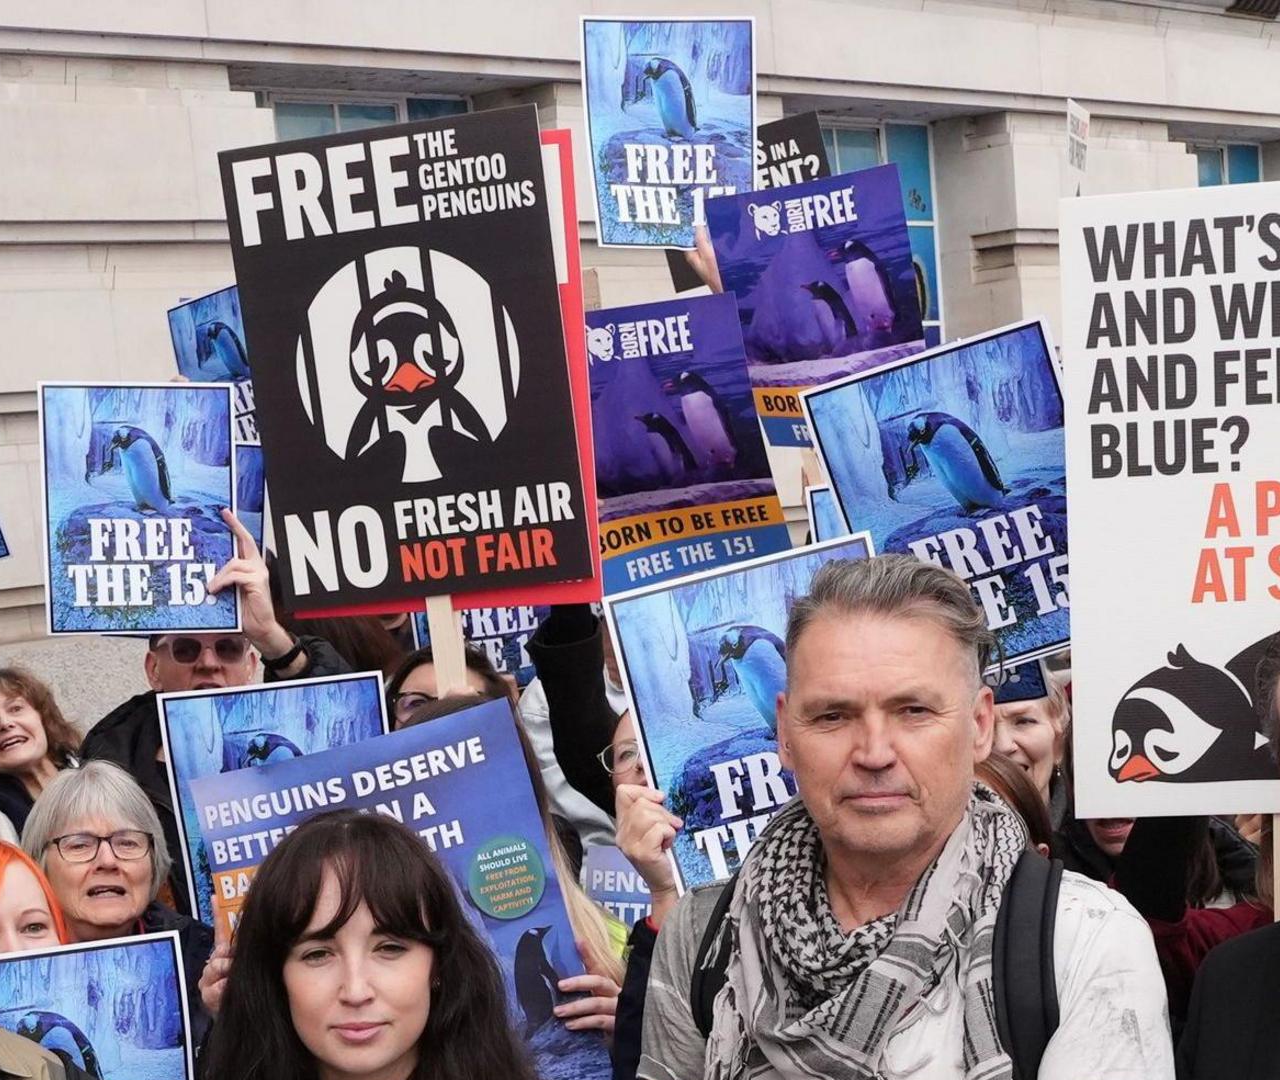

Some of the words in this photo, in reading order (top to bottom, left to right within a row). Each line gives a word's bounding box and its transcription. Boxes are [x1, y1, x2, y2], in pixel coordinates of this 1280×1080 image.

[413, 128, 458, 160] THE
[624, 143, 717, 184] FREE
[770, 143, 788, 159] IN
[788, 139, 801, 156] A
[231, 135, 420, 247] FREE
[418, 153, 507, 190] GENTOO
[422, 180, 536, 222] PENGUINS
[611, 185, 681, 225] THE
[786, 200, 807, 234] BORN
[803, 188, 858, 227] FREE
[635, 314, 694, 356] FREE
[1086, 286, 1197, 349] AND
[619, 322, 640, 360] BORN
[1087, 352, 1198, 414] AND
[1090, 415, 1250, 479] BLUE?
[393, 488, 504, 540] FRESH
[513, 481, 575, 527] AIR
[656, 515, 684, 537] TO
[692, 509, 716, 531] BE
[721, 504, 769, 525] FREE
[1204, 482, 1241, 539] A
[87, 518, 195, 561] FREE
[283, 505, 389, 596] NO
[399, 538, 468, 583] NOT
[476, 528, 557, 575] FAIR
[626, 551, 672, 581] FREE
[676, 542, 714, 569] THE
[721, 536, 756, 559] 15!
[68, 564, 153, 608] THE
[168, 564, 218, 607] 15!
[1191, 546, 1255, 603] AT
[205, 777, 347, 830] PENGUINS
[352, 736, 486, 798] DESERVE
[412, 792, 436, 821] A
[477, 852, 492, 861] ALL
[492, 842, 527, 858] ANIMALS
[479, 858, 511, 873] SHOULD
[512, 853, 529, 864] LIVE
[505, 865, 527, 877] FROM
[515, 886, 532, 898] AND
